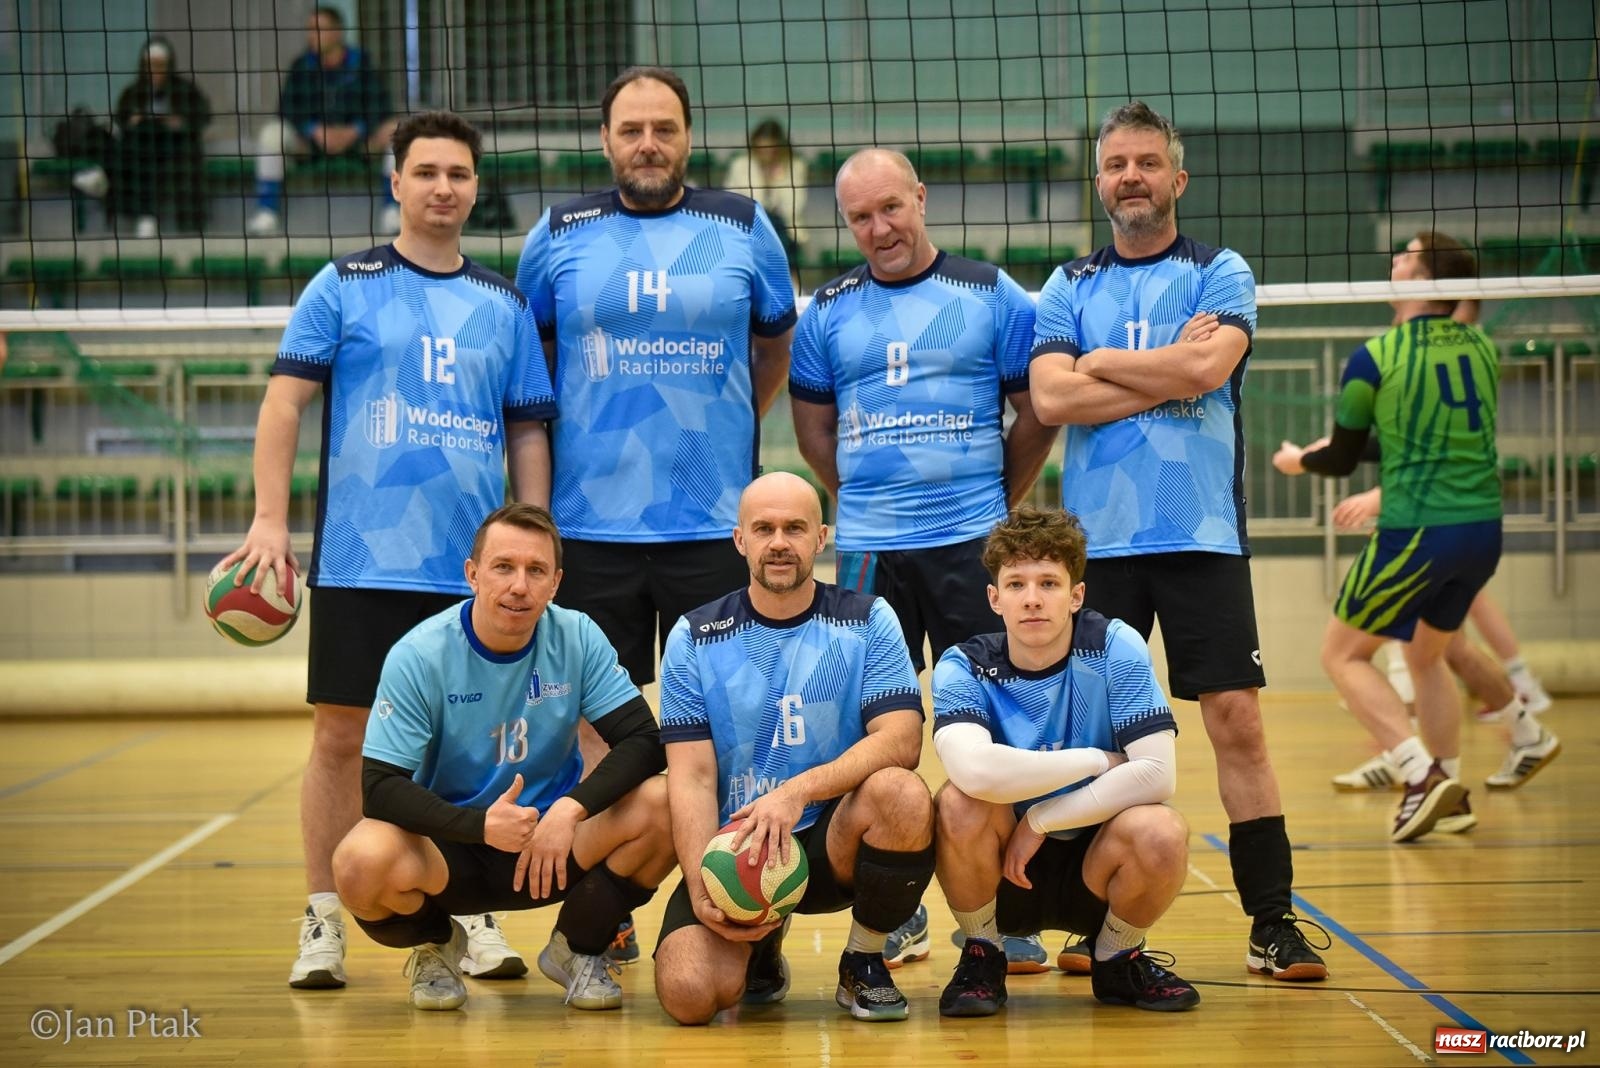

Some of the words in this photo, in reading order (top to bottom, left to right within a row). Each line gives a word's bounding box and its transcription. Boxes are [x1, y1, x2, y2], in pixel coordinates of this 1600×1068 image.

[626, 270, 672, 313] 14
[615, 337, 725, 360] Wodociągi
[1124, 318, 1149, 351] 17
[420, 336, 457, 385] 12
[619, 359, 725, 376] Raciborskie
[886, 341, 909, 387] 8
[1435, 355, 1482, 432] 4
[406, 406, 498, 439] Wodociągi
[865, 410, 974, 431] Wodociągi
[407, 428, 494, 453] Raciborskie
[490, 717, 528, 767] 13
